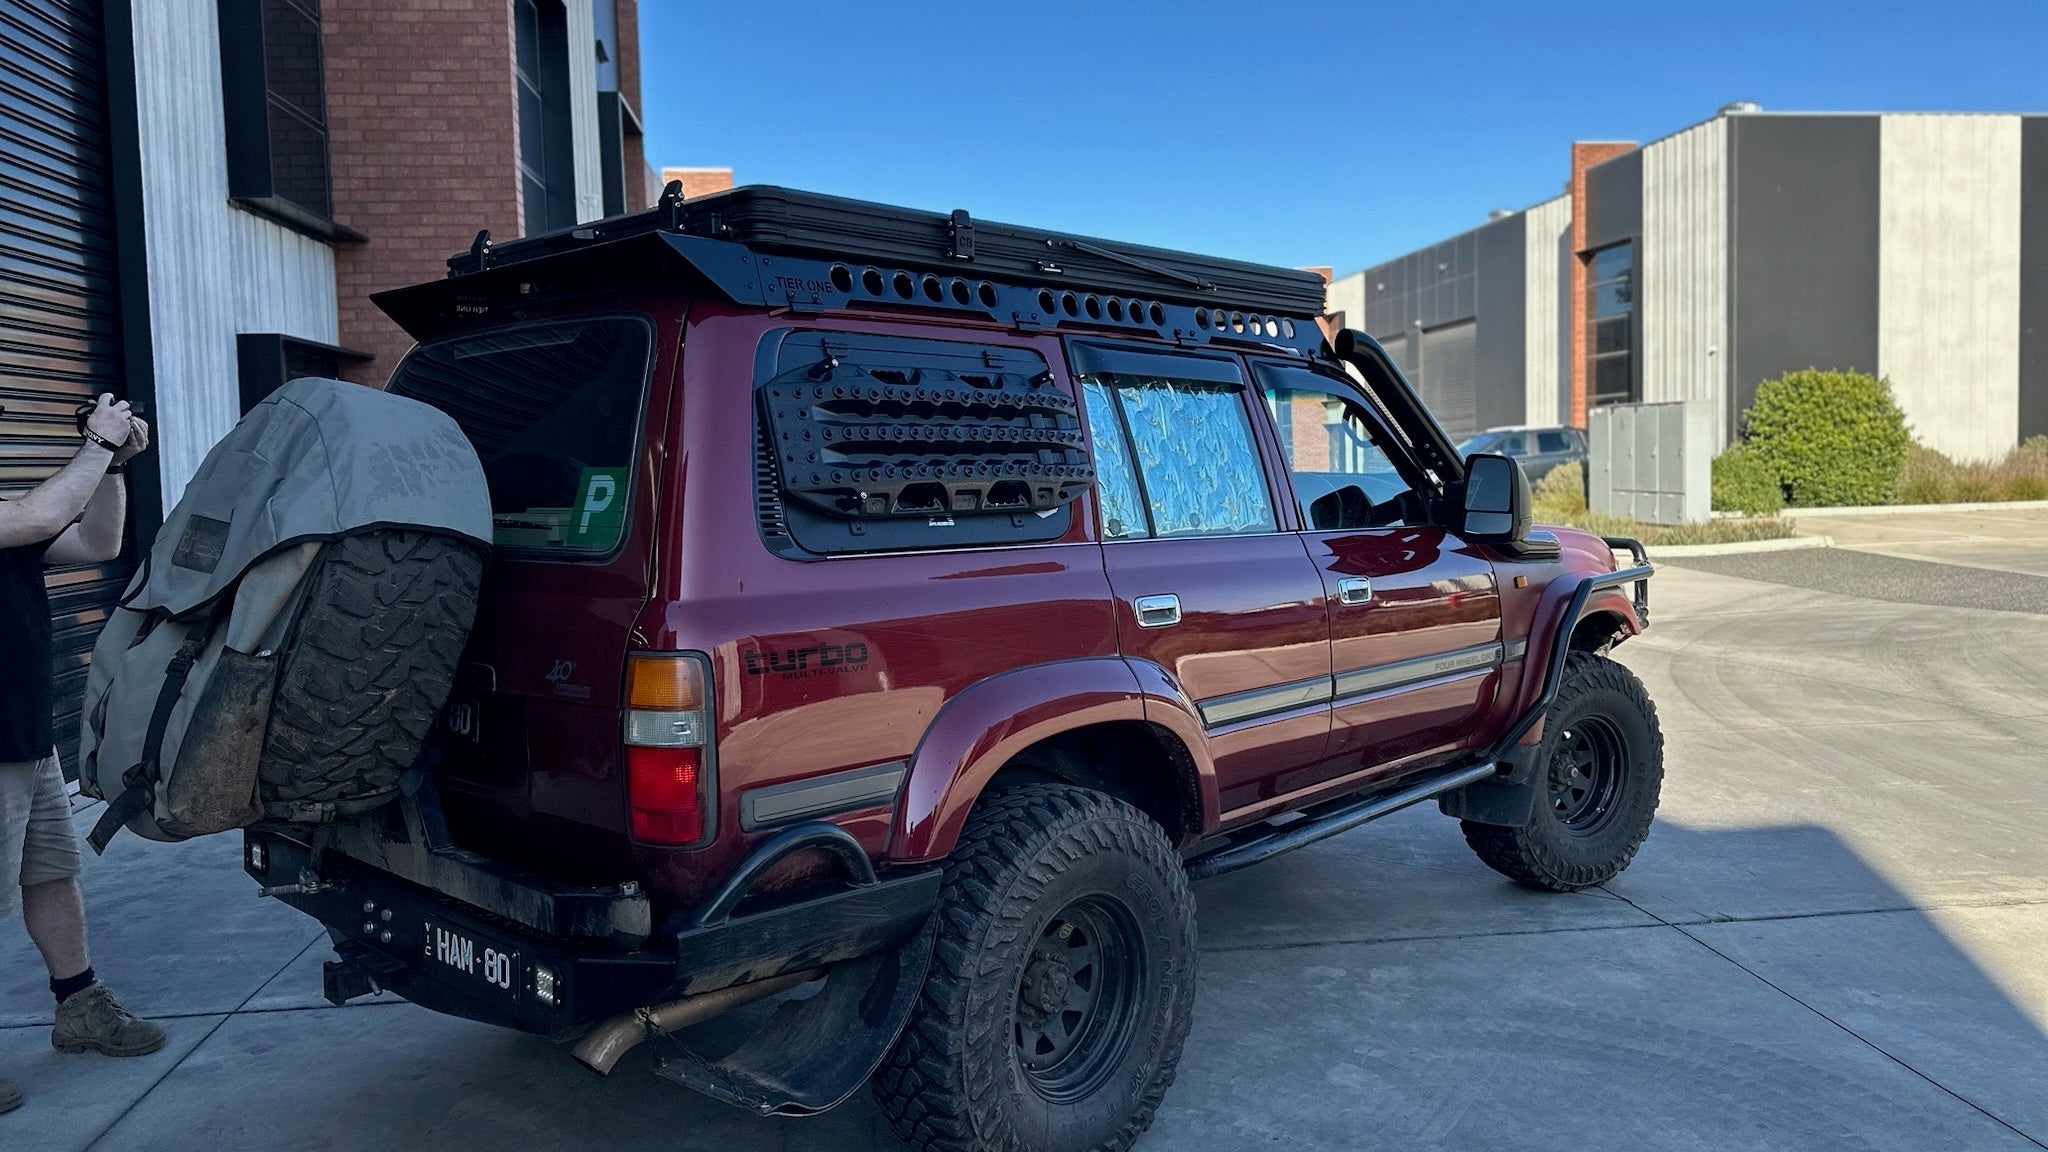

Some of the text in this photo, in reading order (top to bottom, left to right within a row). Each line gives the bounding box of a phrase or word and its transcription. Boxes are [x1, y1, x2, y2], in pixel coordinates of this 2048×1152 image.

[775, 275, 833, 293] TIER ONE
[578, 474, 616, 534] P
[743, 642, 868, 675] turbo
[782, 665, 868, 681] MULTI-VALVE
[1435, 659, 1456, 671] FOUR
[1456, 654, 1481, 667] WHEEL
[424, 921, 432, 957] VIC
[436, 927, 511, 990] HAM 80
